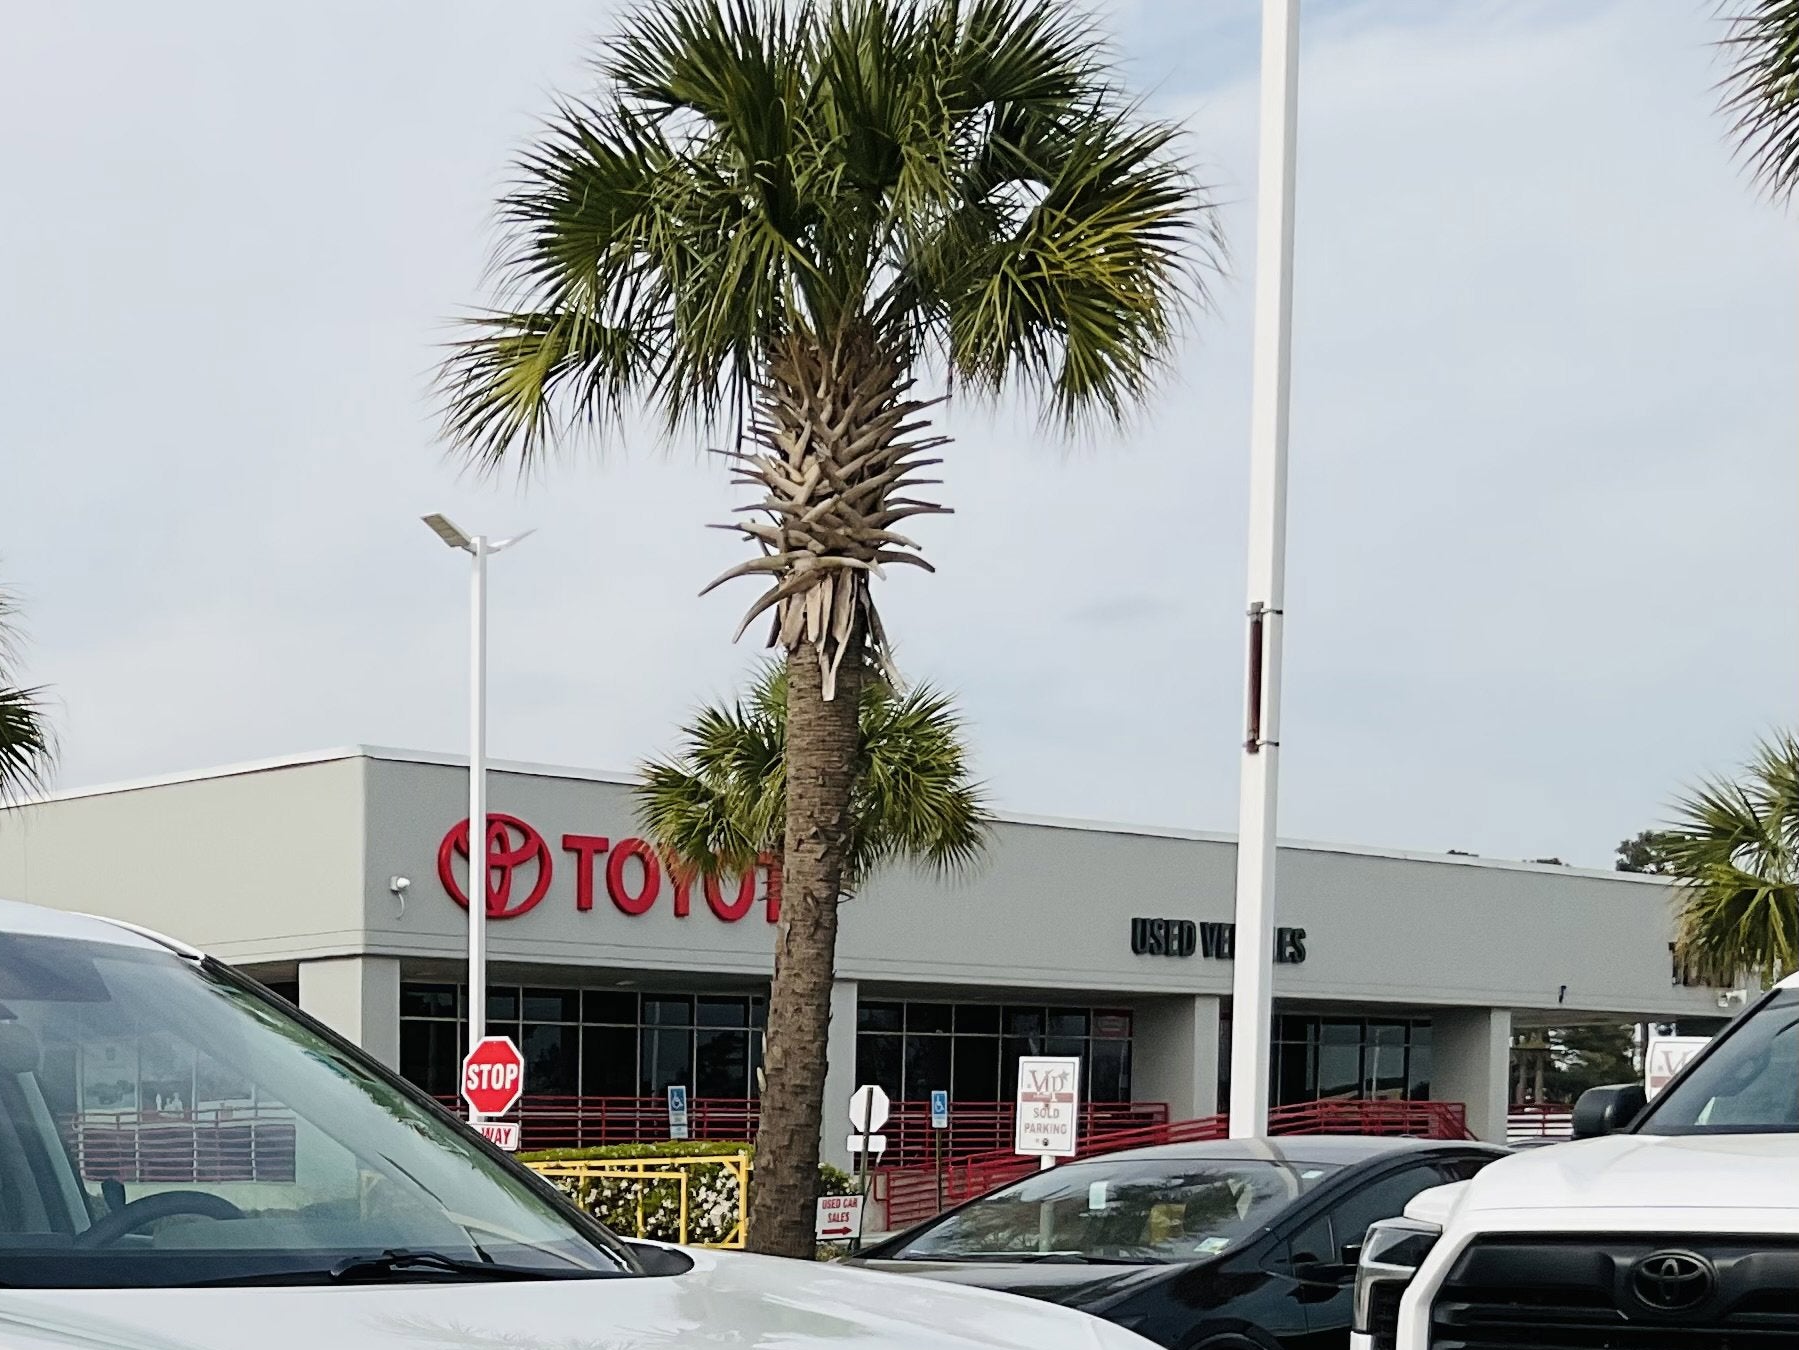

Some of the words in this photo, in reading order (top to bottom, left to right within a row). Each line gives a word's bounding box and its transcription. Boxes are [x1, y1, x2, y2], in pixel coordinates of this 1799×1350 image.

[562, 833, 784, 923] TOYOT
[1131, 917, 1196, 957] USED
[1200, 921, 1307, 964] VEES
[466, 1062, 519, 1092] STOP
[1033, 1107, 1060, 1119] SOLD
[1024, 1122, 1068, 1135] PARKING
[822, 1198, 840, 1209] USED
[843, 1197, 858, 1208] CAR
[827, 1211, 850, 1223] SALES
